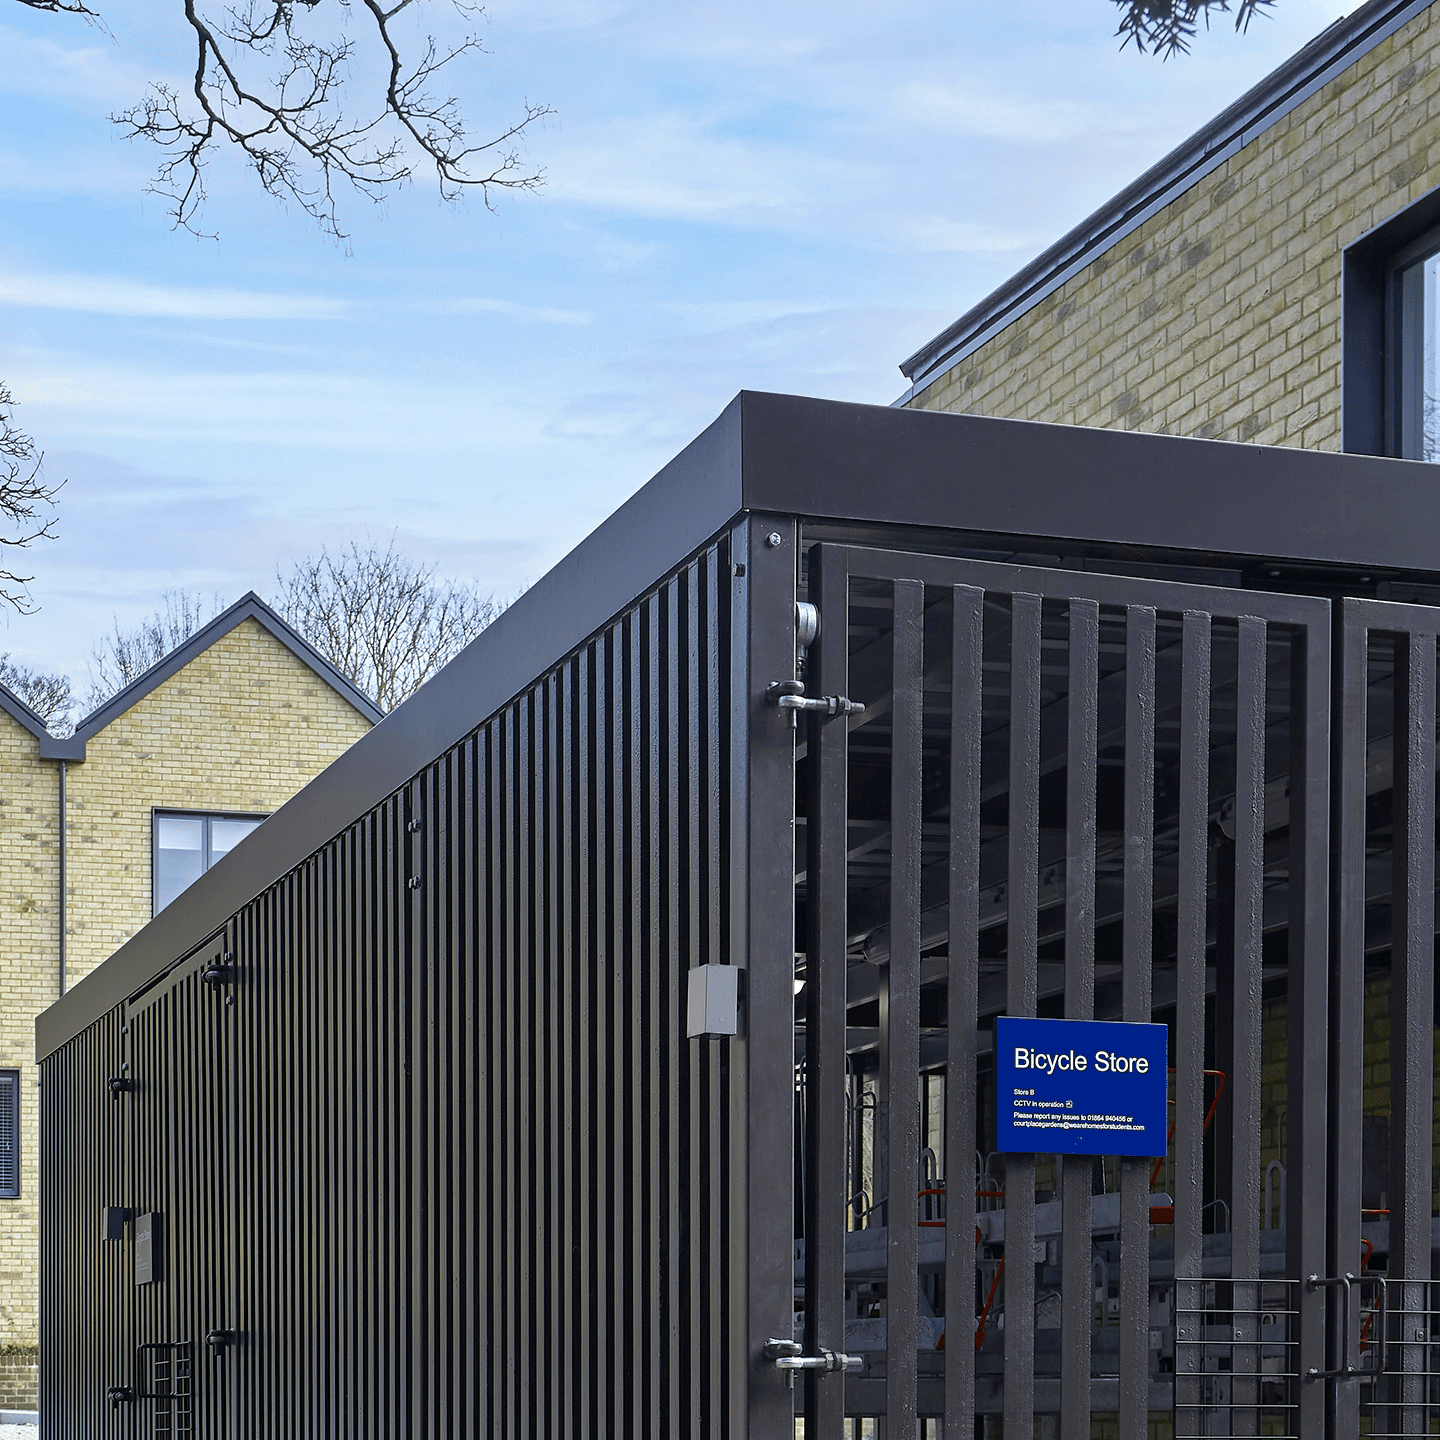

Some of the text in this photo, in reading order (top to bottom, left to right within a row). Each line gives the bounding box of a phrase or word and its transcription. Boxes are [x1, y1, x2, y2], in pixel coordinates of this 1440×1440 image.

[1014, 1047, 1149, 1075] Bicycle Store
[1013, 1088, 1029, 1096] Store
[1013, 1099, 1031, 1107] CCTV
[1038, 1100, 1064, 1109] operation
[1013, 1111, 1033, 1119] Please
[1033, 1112, 1050, 1121] report
[1051, 1113, 1062, 1121] any
[1062, 1113, 1080, 1121] issues
